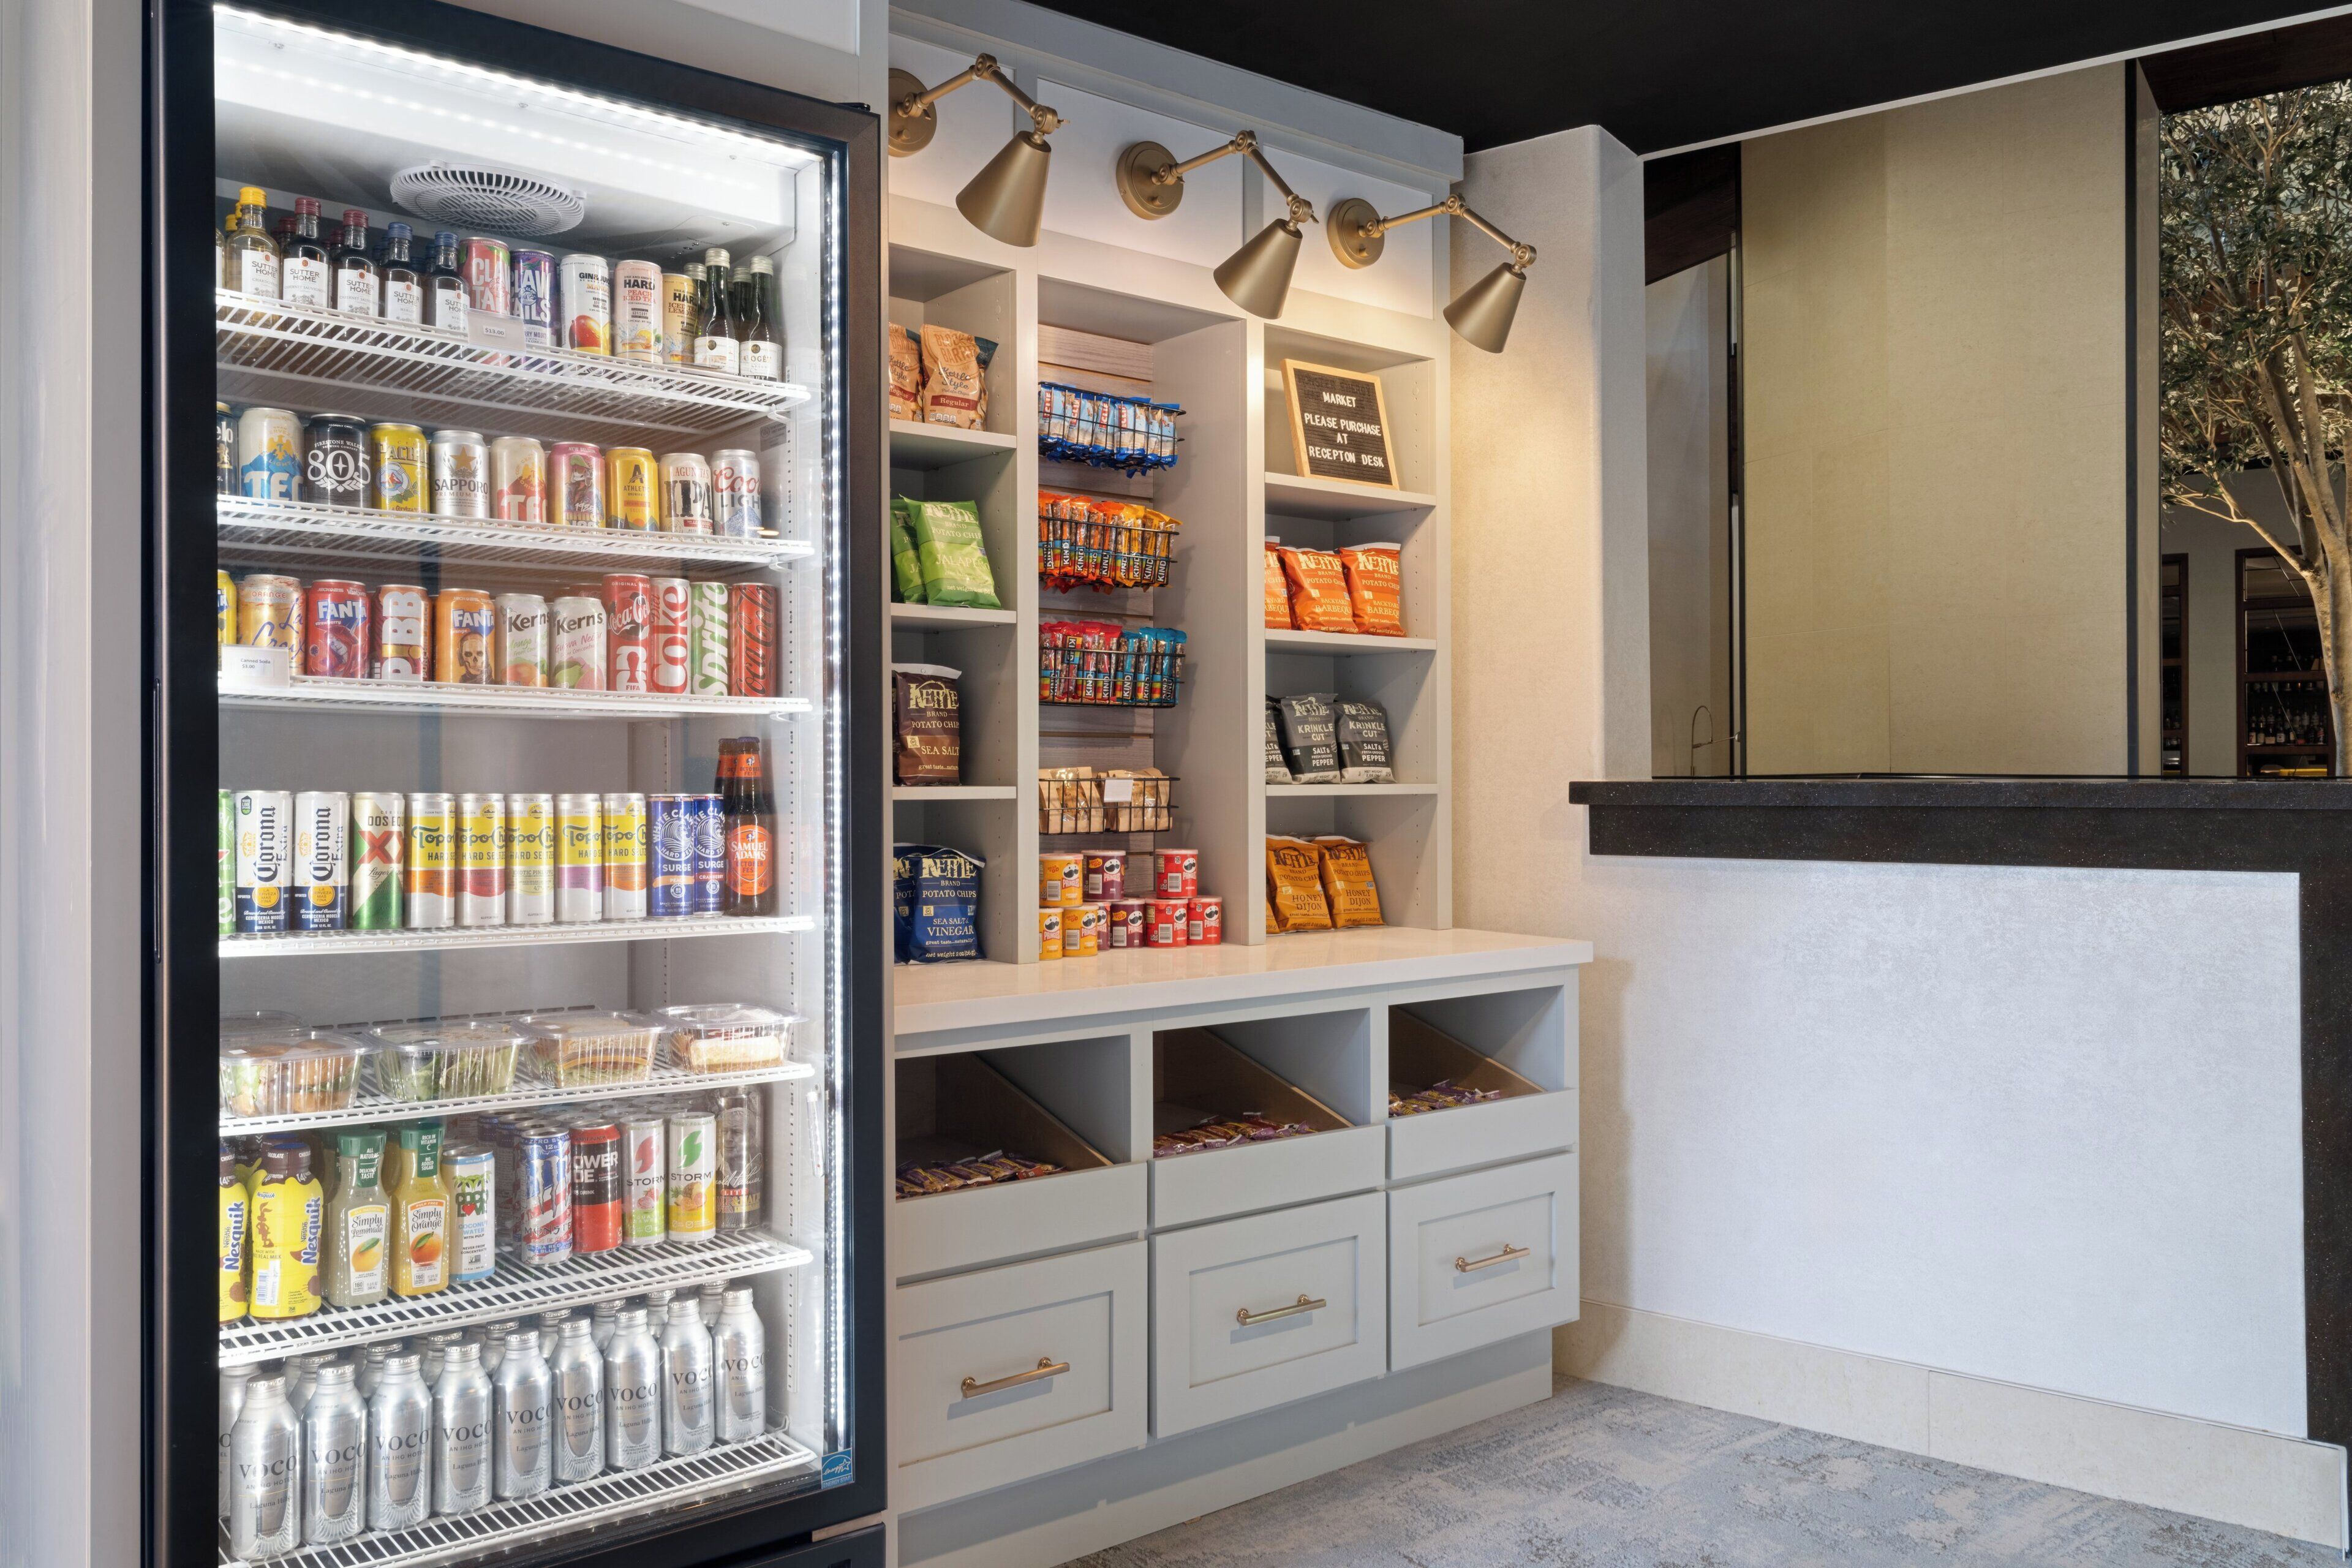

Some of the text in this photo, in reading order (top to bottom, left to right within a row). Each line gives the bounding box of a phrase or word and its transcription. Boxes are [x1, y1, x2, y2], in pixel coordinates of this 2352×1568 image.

[252, 261, 278, 273] SUTTER
[256, 268, 276, 278] HOME
[290, 269, 320, 277] SUTTER
[346, 279, 374, 290] SUTTER
[350, 286, 371, 295] HOME
[624, 279, 655, 290] HARD
[939, 367, 971, 381] Kettle
[941, 377, 970, 390] Style
[940, 398, 969, 407] Regular
[1322, 391, 1356, 408] MARKET
[1304, 413, 1382, 436] PLEASE PURCHASE
[1336, 432, 1348, 445] AT
[346, 441, 365, 452] WALKER
[1308, 446, 1385, 468] RECEPTON DESK
[307, 450, 371, 485] 805
[434, 478, 488, 494] SAPPORO
[932, 527, 961, 537] POTATO
[1144, 558, 1153, 580] KIND
[1158, 560, 1167, 582] KIND
[279, 597, 303, 633] La
[318, 600, 367, 619] FANTA
[653, 586, 688, 693] Coke
[1123, 674, 1132, 697] KIND
[1297, 722, 1334, 734] KRINKLE
[1349, 721, 1385, 731] KRINKLE
[921, 745, 960, 756] SEA SALT
[368, 816, 389, 826] DOS
[253, 805, 278, 883] Corona
[276, 825, 288, 866] Extra
[309, 806, 334, 882] Corona
[331, 825, 344, 865] Extra
[731, 841, 768, 851] SAMUEL
[462, 852, 484, 861] HARD
[734, 850, 766, 861] ADAMS
[663, 864, 692, 872] SURGE
[1063, 878, 1079, 888] PRINGLES
[1292, 894, 1322, 903] HONEY
[1350, 897, 1371, 906] DIJON
[1296, 903, 1322, 912] DIJON
[927, 925, 974, 937] VINEGAR
[627, 1174, 667, 1186] STORM
[671, 1171, 712, 1182] STORM
[352, 1214, 383, 1228] Simply
[412, 1208, 442, 1223] Simply
[301, 1196, 322, 1265] Nesquik
[351, 1225, 383, 1237] Lemonade
[411, 1218, 442, 1233] Orange
[458, 1221, 488, 1229] COCONUT
[224, 1200, 245, 1270] Nesquik
[407, 1450, 426, 1458] HOTEL
[345, 1463, 362, 1472] HOTEL
[385, 1472, 409, 1480] Laguna
[823, 1475, 851, 1488] ENERGY STAR
[321, 1485, 347, 1494] Laguna
